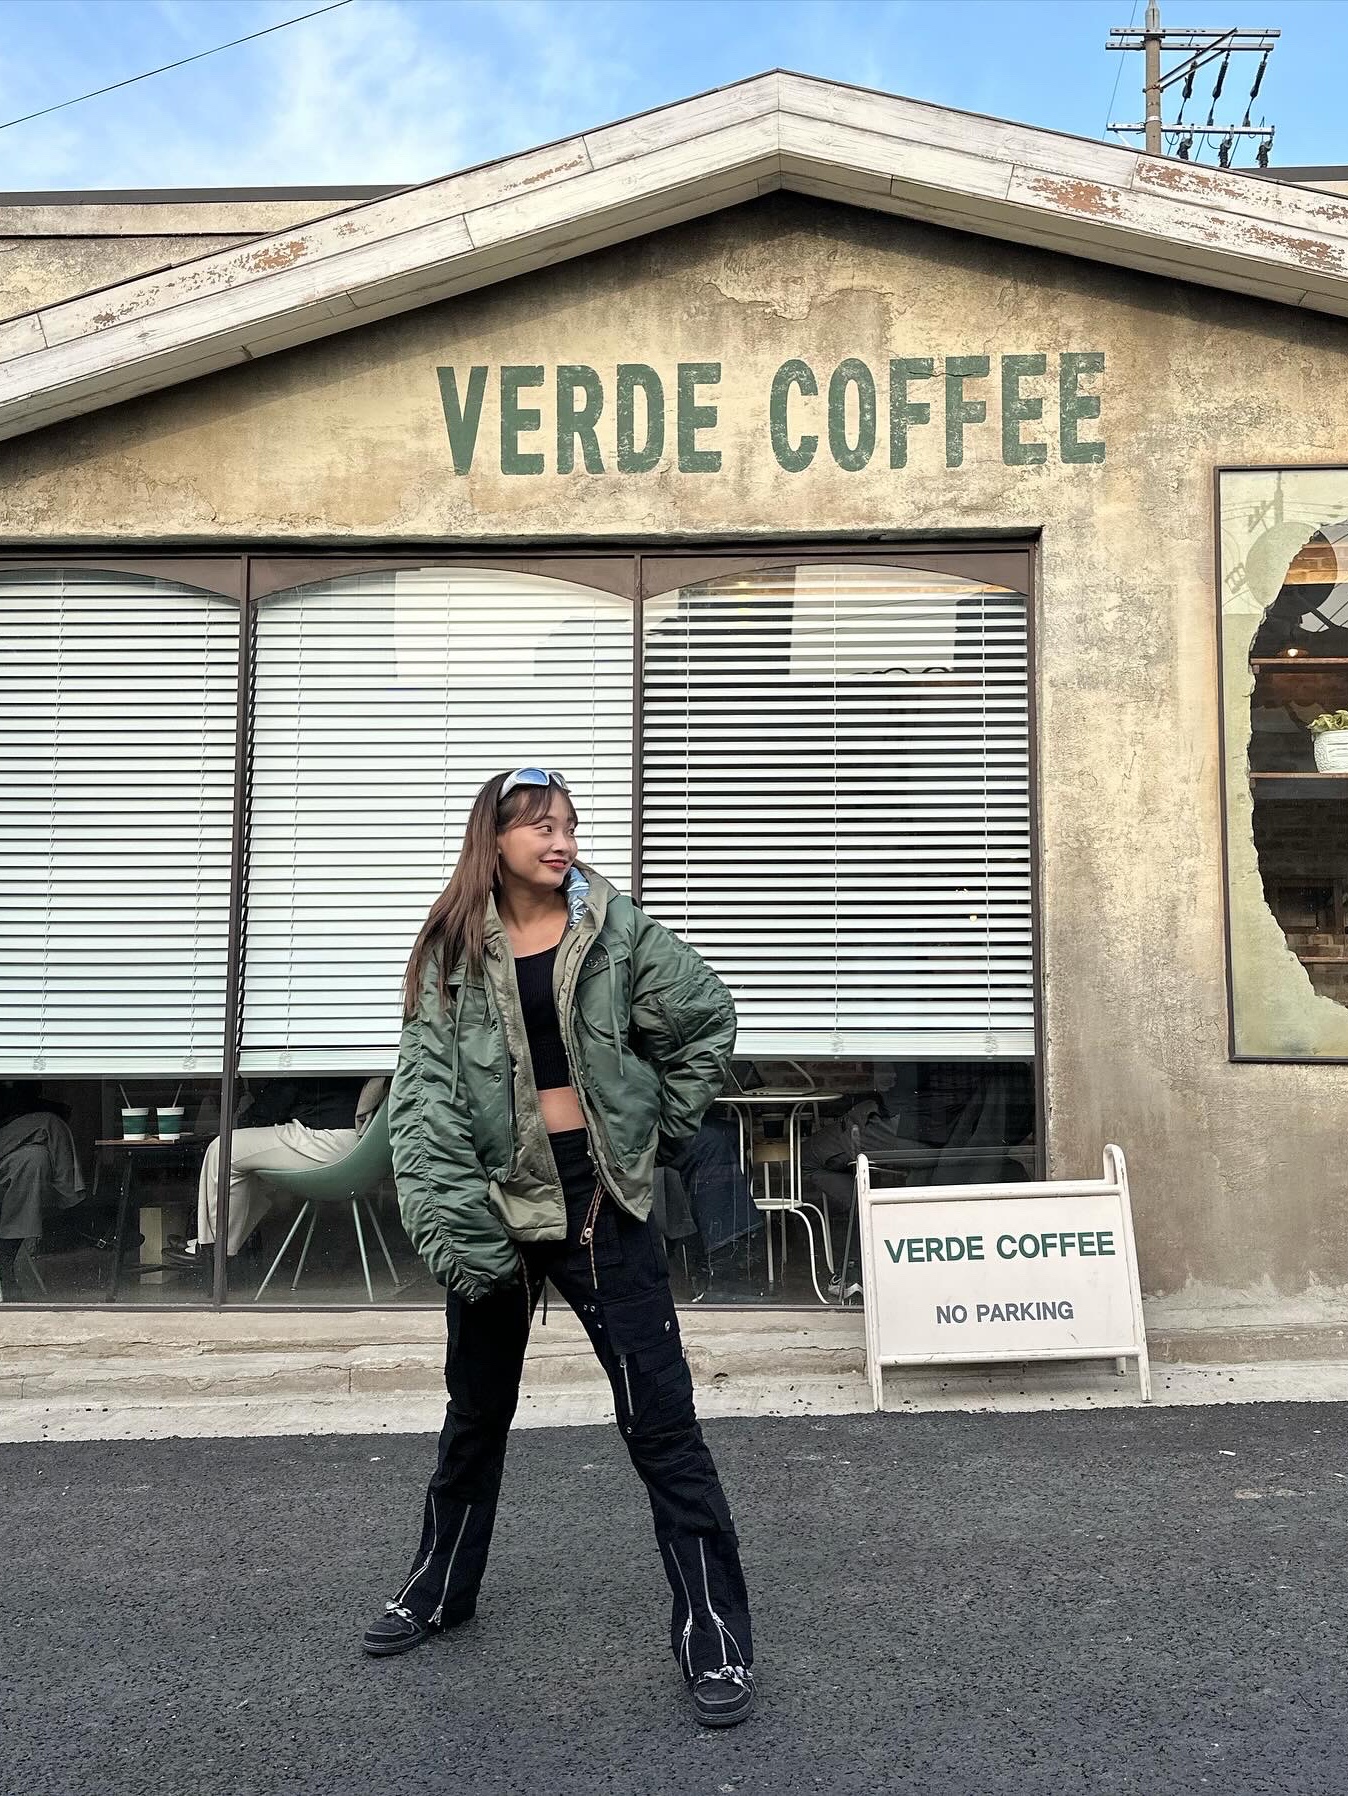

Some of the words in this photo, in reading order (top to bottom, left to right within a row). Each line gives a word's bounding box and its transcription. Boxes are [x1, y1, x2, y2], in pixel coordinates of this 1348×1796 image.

[436, 362, 721, 475] VERDE
[769, 352, 1106, 473] COFFEE
[884, 1236, 985, 1263] VERDE
[996, 1231, 1116, 1260] COFFEE
[936, 1305, 968, 1324] NO
[976, 1301, 1074, 1323] PARKING
